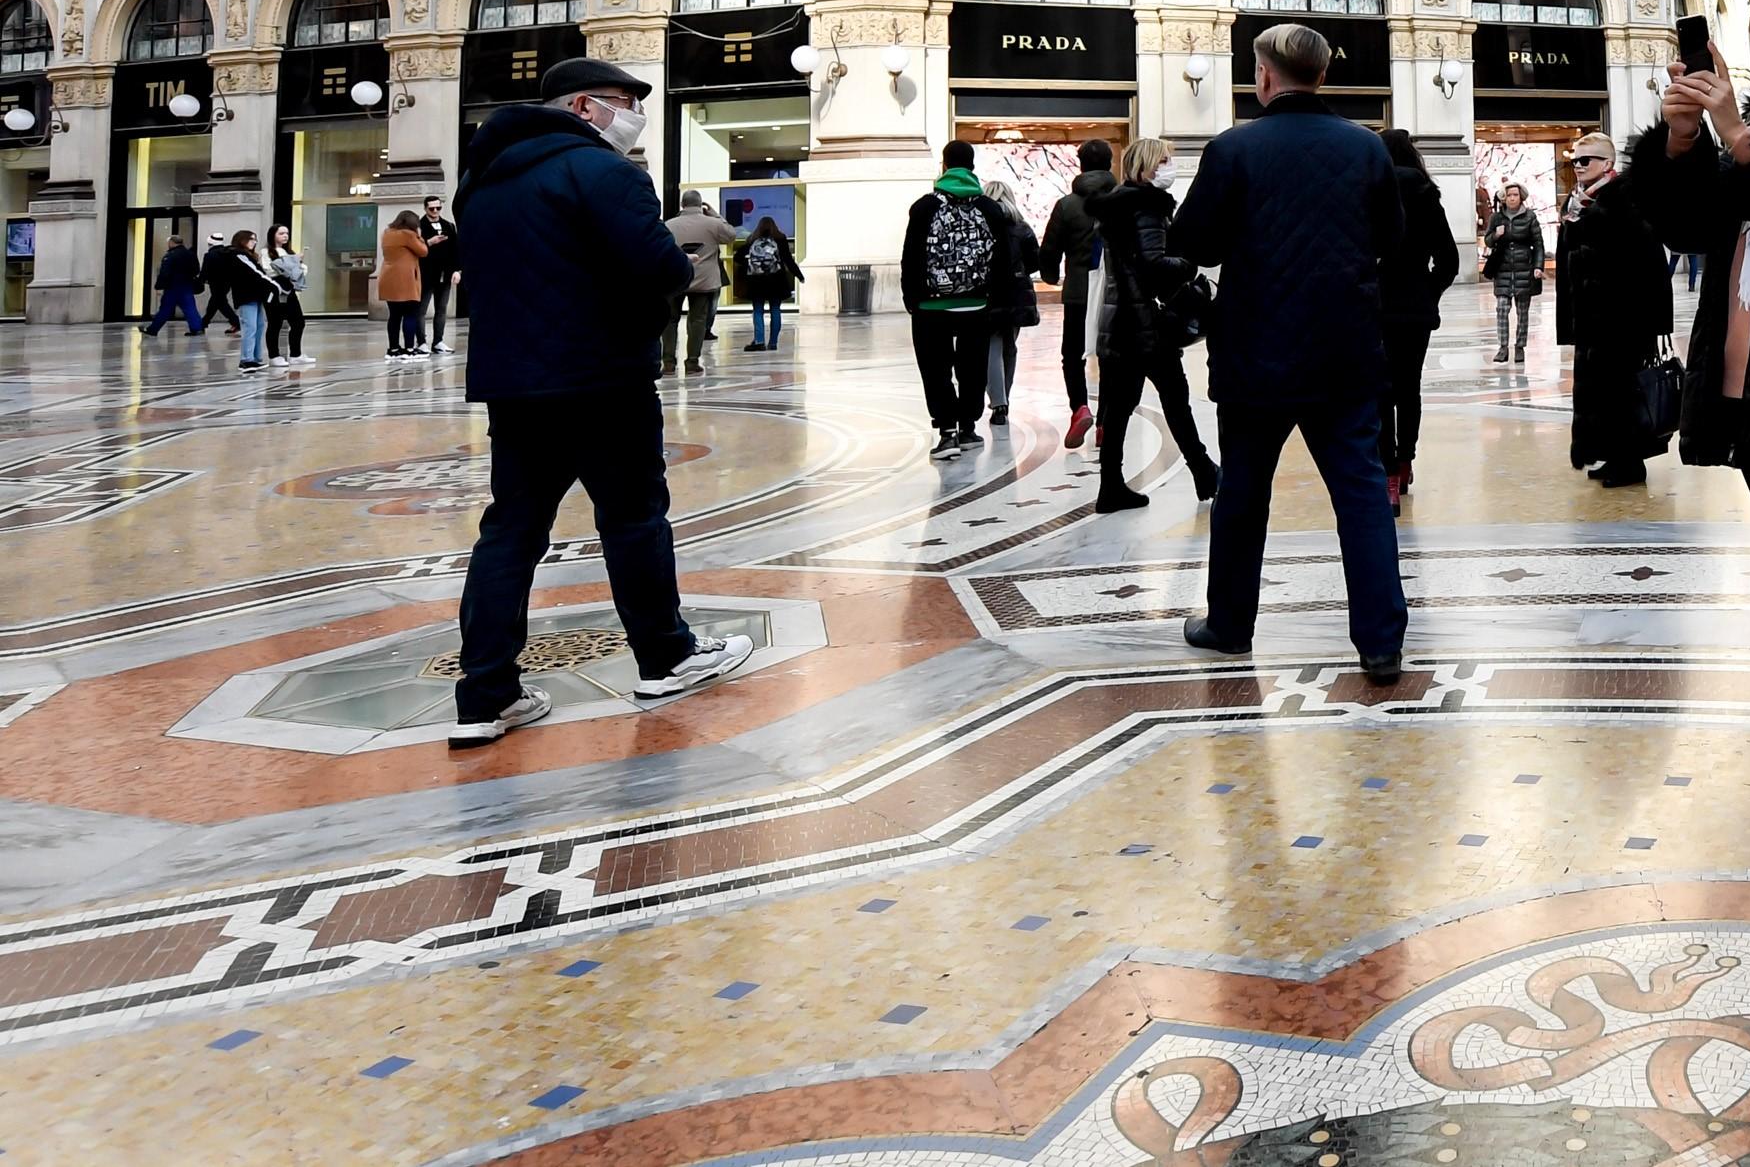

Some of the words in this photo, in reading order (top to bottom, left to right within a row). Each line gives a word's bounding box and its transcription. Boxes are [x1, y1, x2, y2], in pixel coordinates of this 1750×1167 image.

[1002, 34, 1087, 51] PRADA
[1508, 51, 1570, 65] PRADA
[145, 80, 185, 107] TIM
